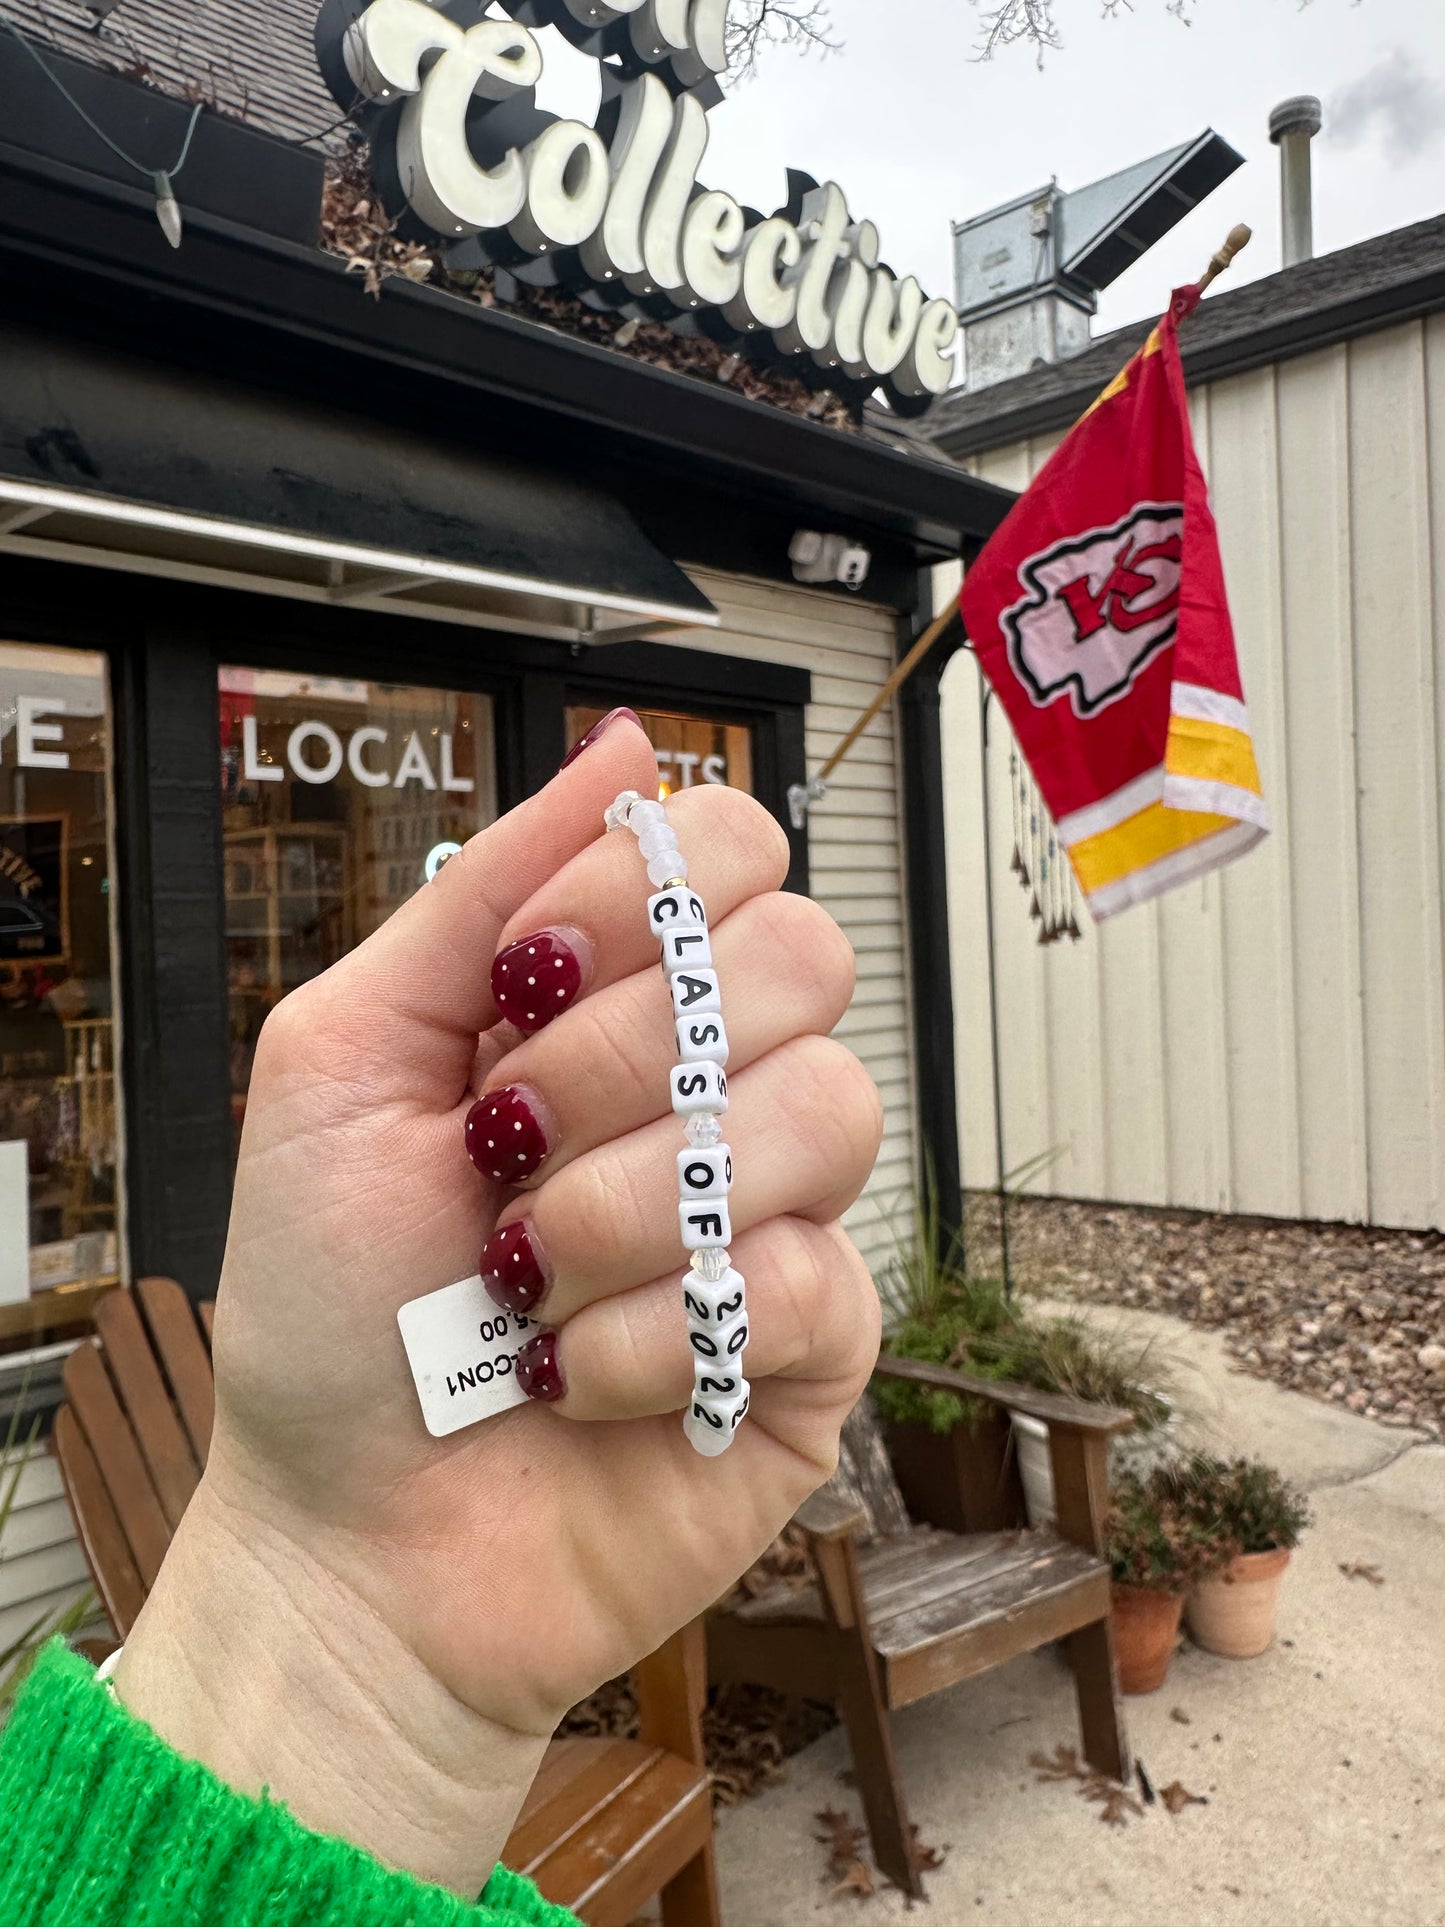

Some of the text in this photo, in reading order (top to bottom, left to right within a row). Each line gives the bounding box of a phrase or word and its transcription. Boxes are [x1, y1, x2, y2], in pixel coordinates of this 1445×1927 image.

[350, 0, 958, 397] Collective
[0, 695, 69, 769] E
[243, 715, 475, 792] LOCAL
[653, 897, 738, 1429] CLASS OF 2022
[480, 1312, 538, 1342] 5.00
[446, 1346, 524, 1396] -CON1
